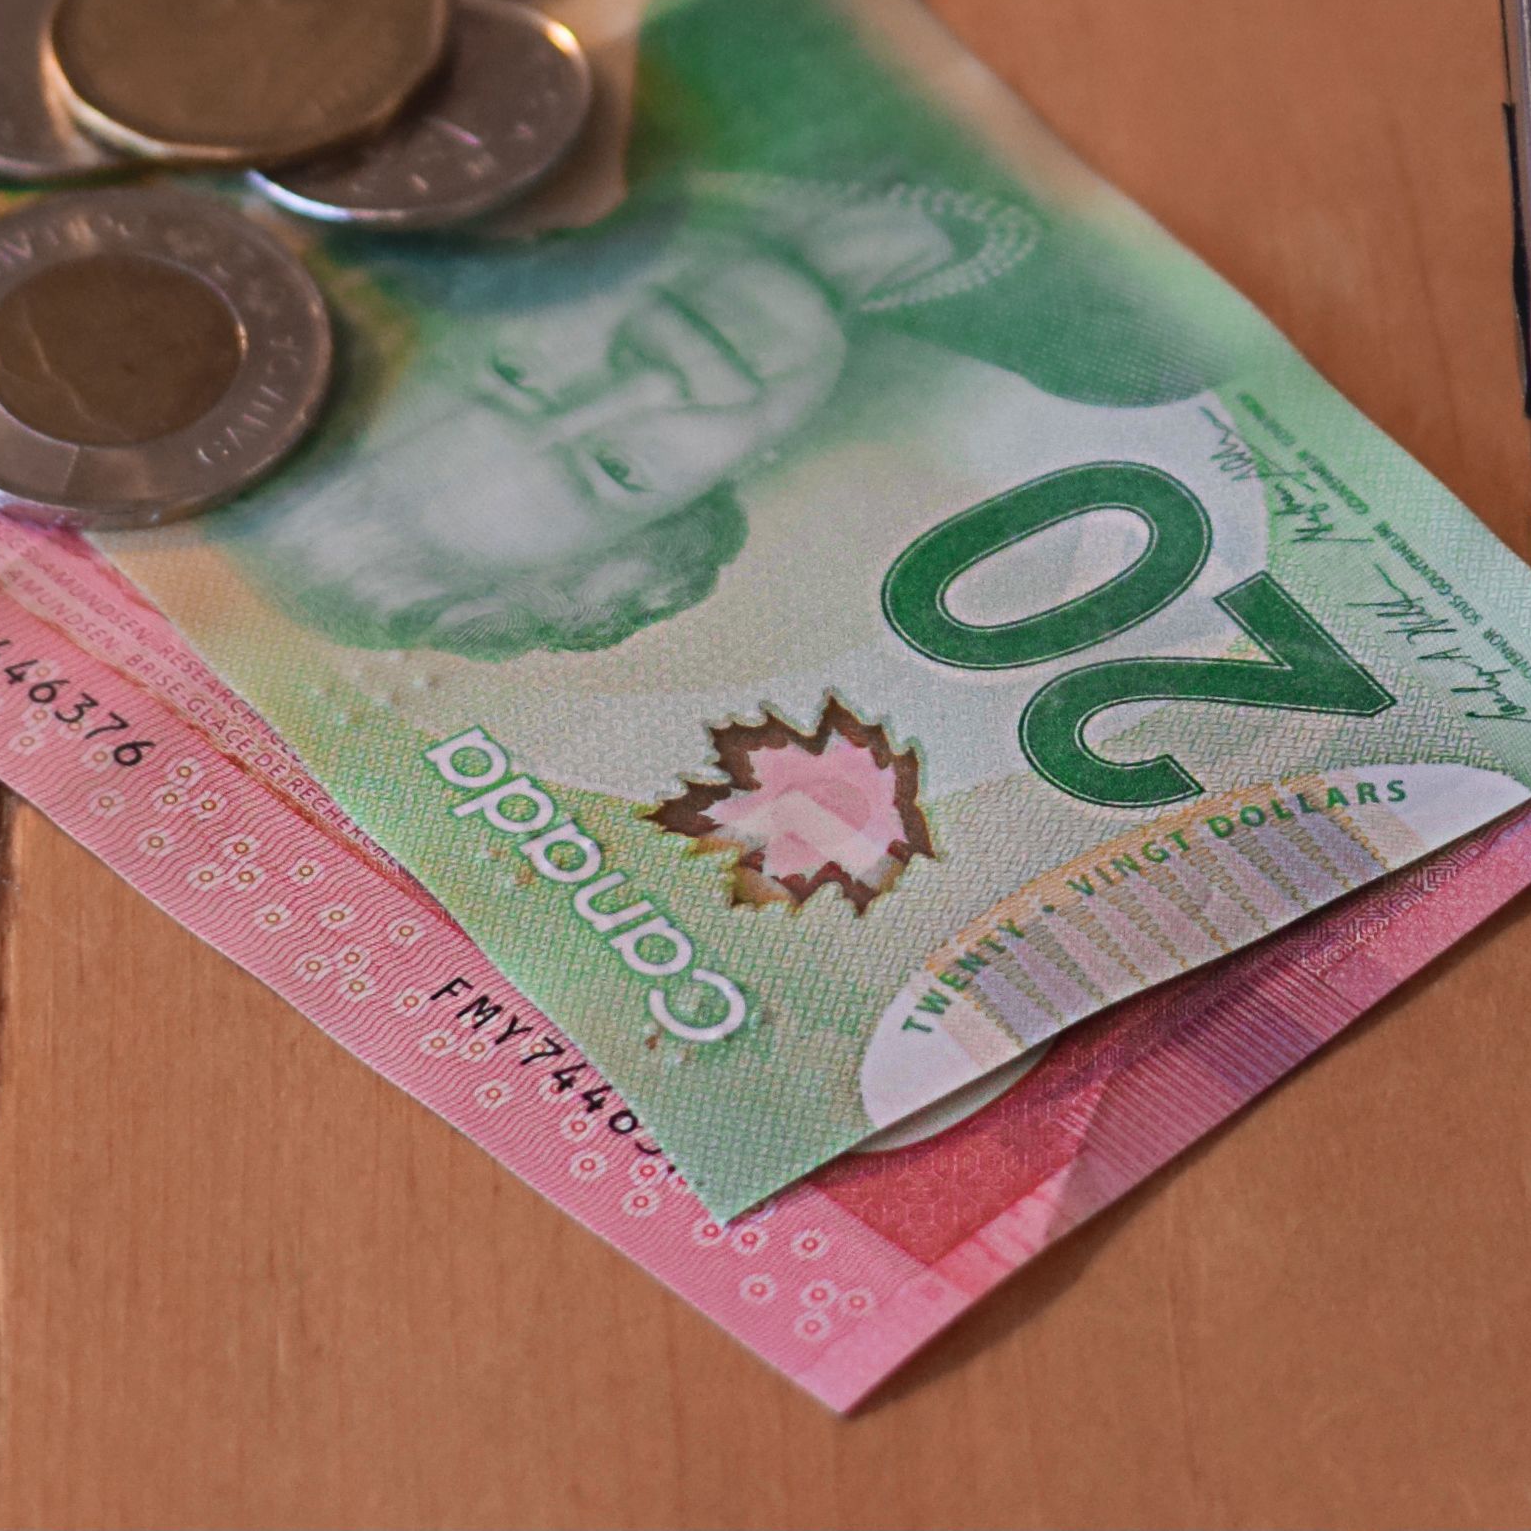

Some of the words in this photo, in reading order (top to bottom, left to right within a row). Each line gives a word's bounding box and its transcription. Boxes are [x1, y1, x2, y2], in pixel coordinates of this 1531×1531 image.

[124, 650, 255, 755] BRISE-GLACE
[880, 459, 1398, 809] 20
[424, 724, 748, 1043] Canada
[900, 921, 1027, 1036] TWENTY
[1067, 830, 1194, 899] VINGT
[1207, 777, 1410, 841] DOLLARS
